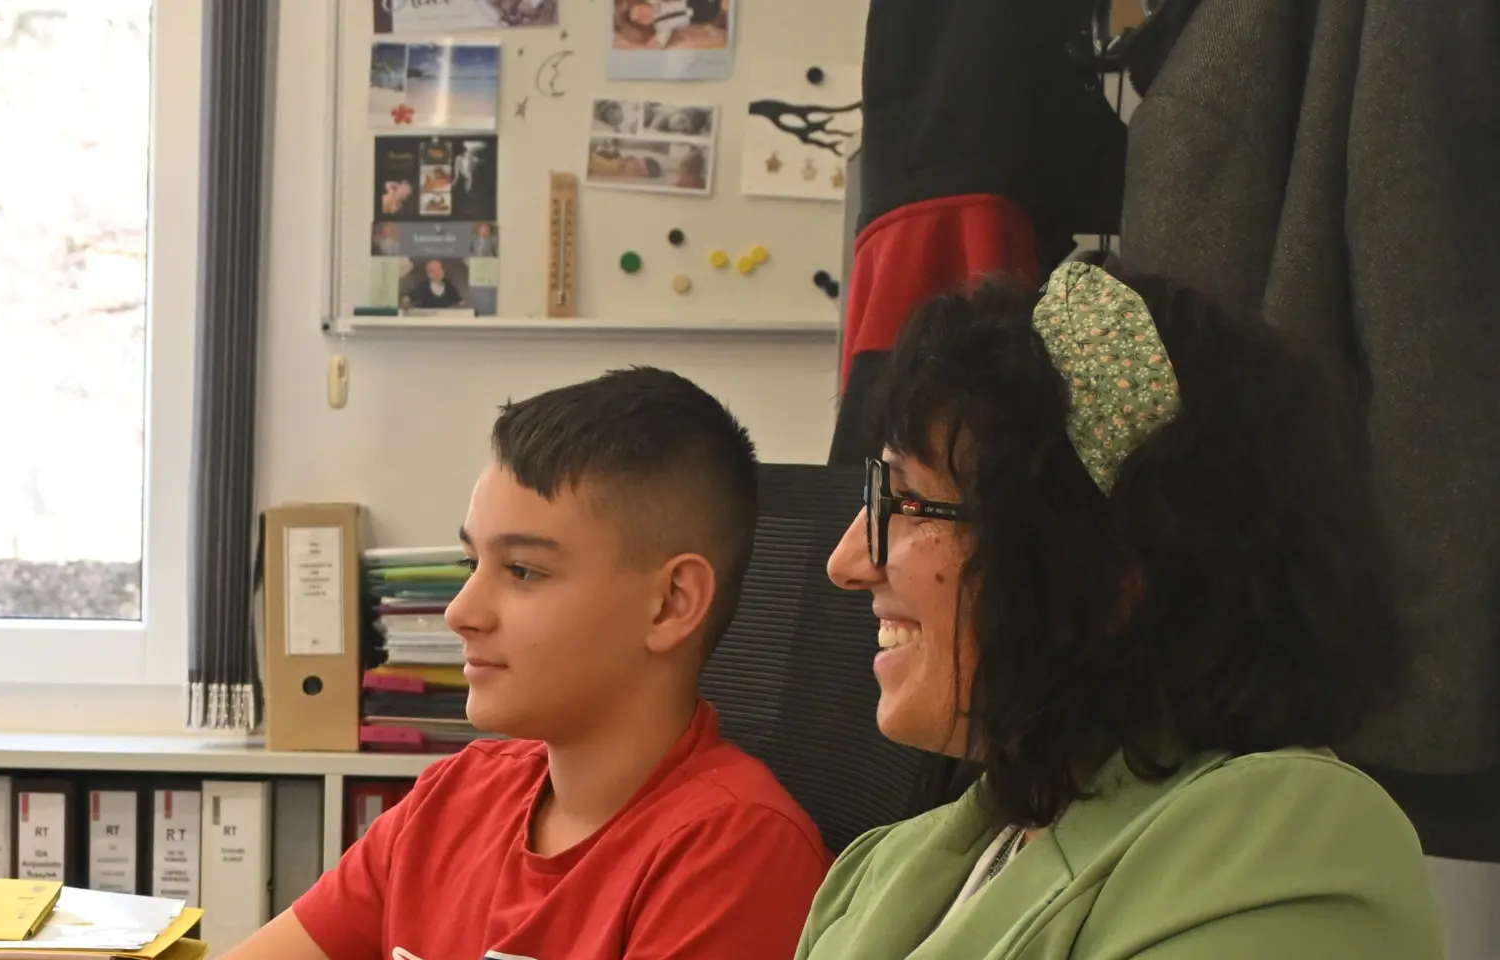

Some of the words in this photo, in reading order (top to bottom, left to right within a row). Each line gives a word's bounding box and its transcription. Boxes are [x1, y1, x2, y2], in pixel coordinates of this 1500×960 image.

[34, 826, 49, 837] RT
[105, 824, 120, 836] RT
[223, 826, 237, 836] RT
